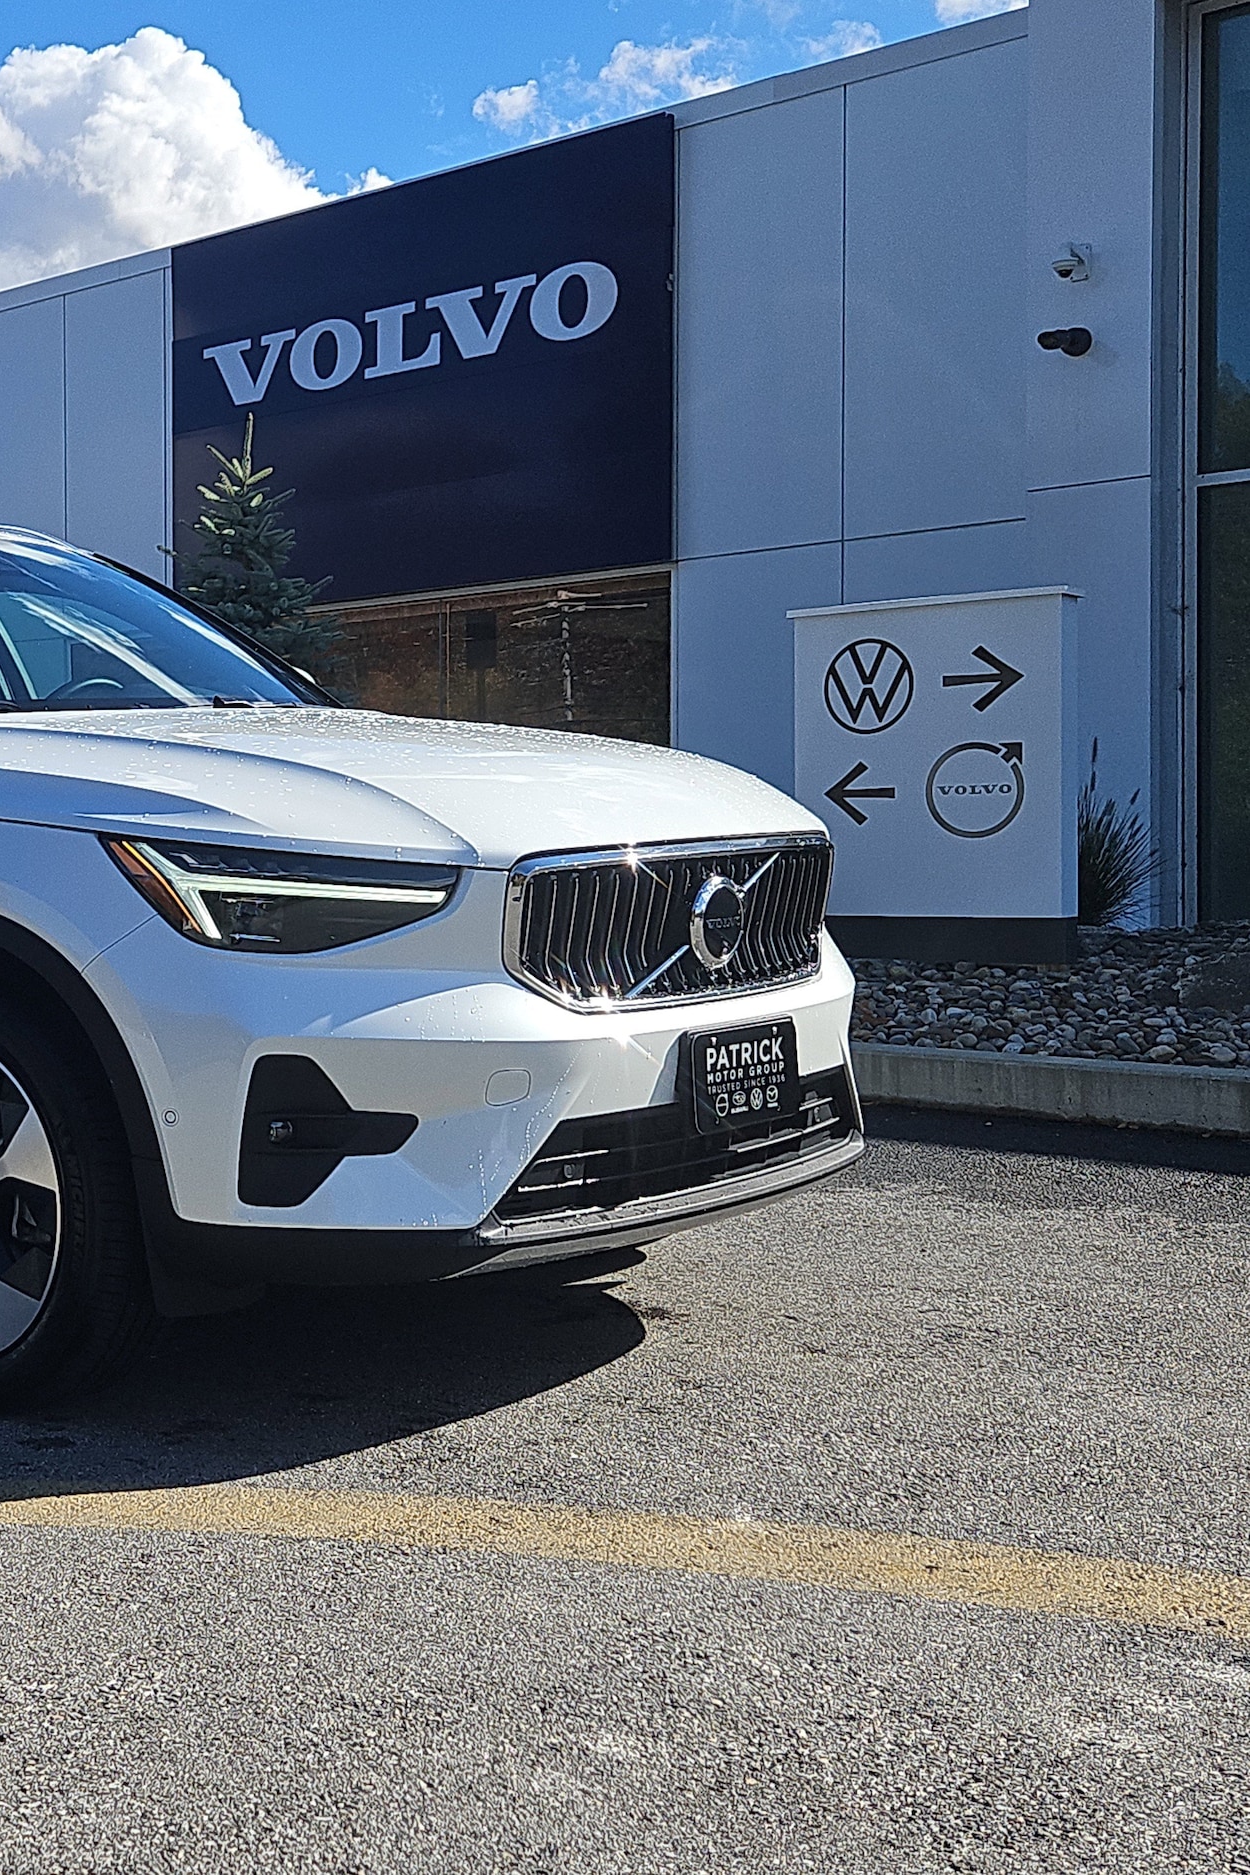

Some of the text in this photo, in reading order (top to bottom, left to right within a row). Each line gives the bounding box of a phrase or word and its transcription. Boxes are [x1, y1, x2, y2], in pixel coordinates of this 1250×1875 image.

[203, 260, 618, 406] VOLVO
[937, 783, 1013, 796] VOLVO
[706, 1036, 784, 1072] PATRICK
[707, 1061, 784, 1084] MOTOR GROUP
[708, 1081, 741, 1095] TRUSTED
[744, 1077, 765, 1088] SINCE
